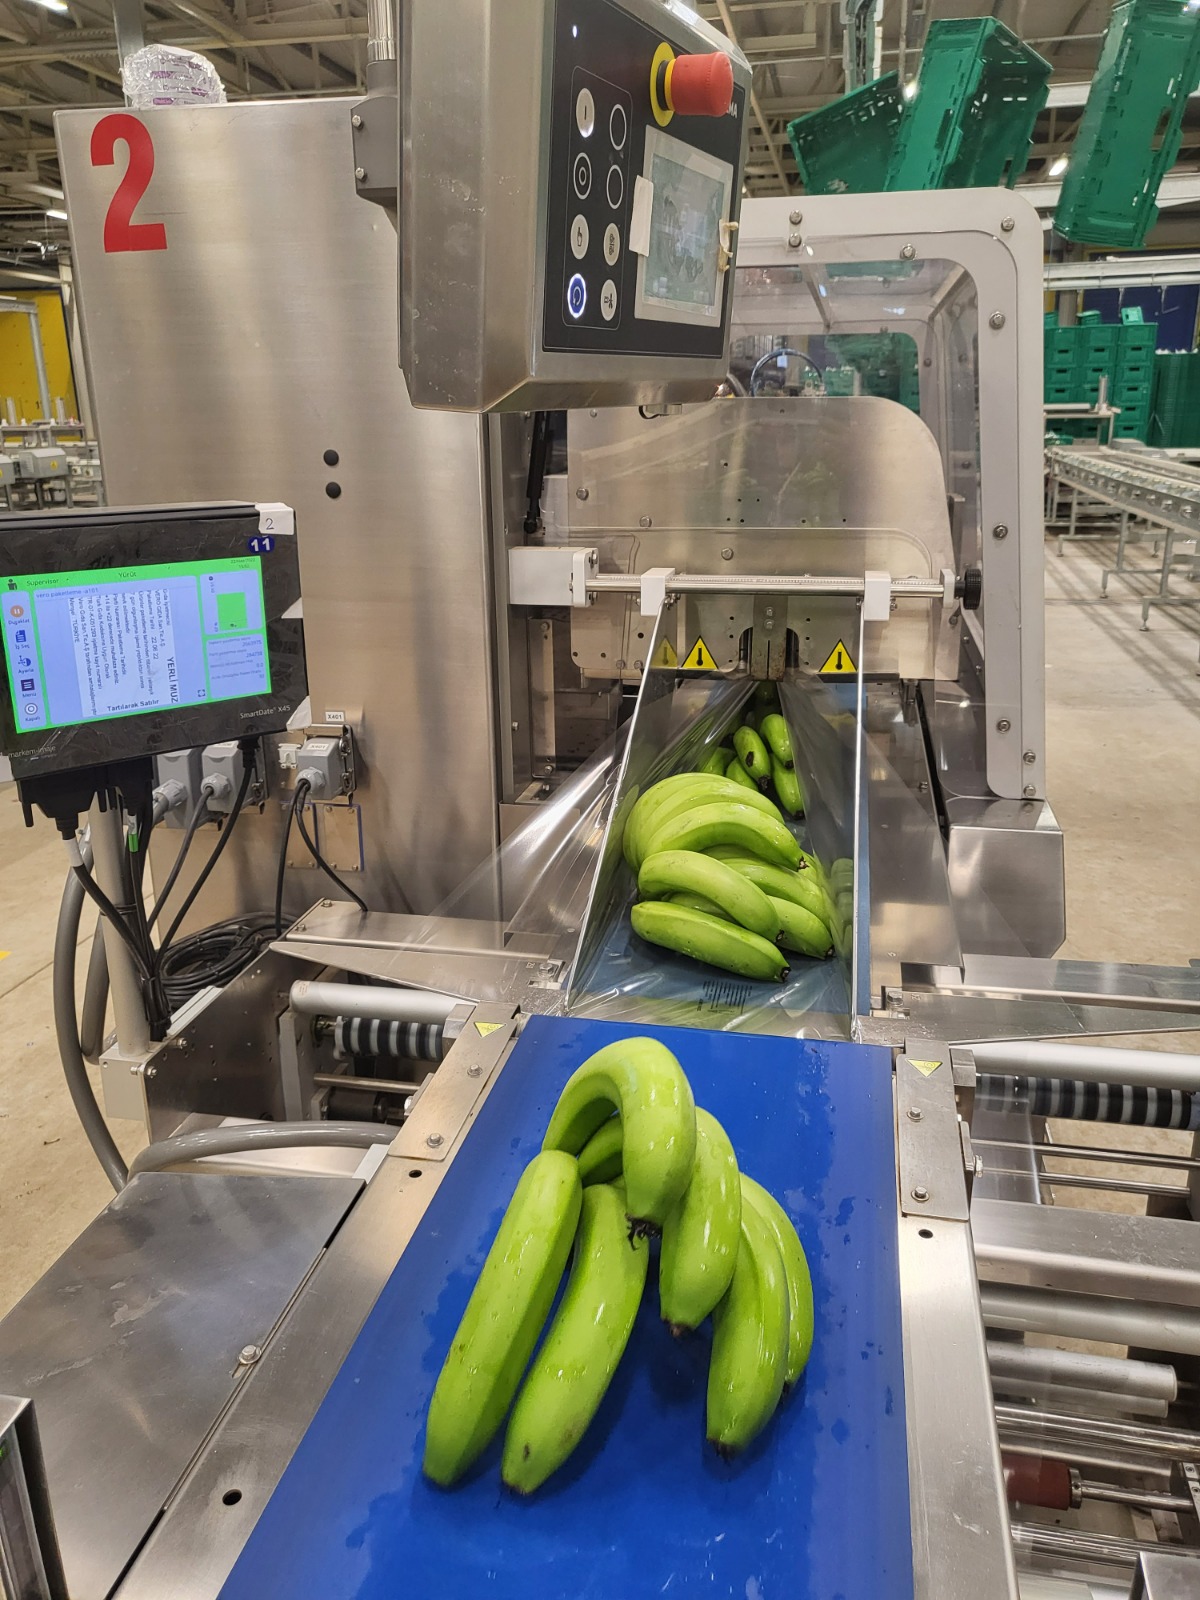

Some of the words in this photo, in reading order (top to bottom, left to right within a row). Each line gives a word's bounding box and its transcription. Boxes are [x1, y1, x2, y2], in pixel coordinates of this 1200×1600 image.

[90, 113, 167, 253] 2
[266, 518, 274, 530] 2
[251, 538, 270, 552] 11
[166, 657, 178, 682] YERLİ
[170, 684, 178, 703] MUZ
[108, 702, 138, 711] Tartılarak
